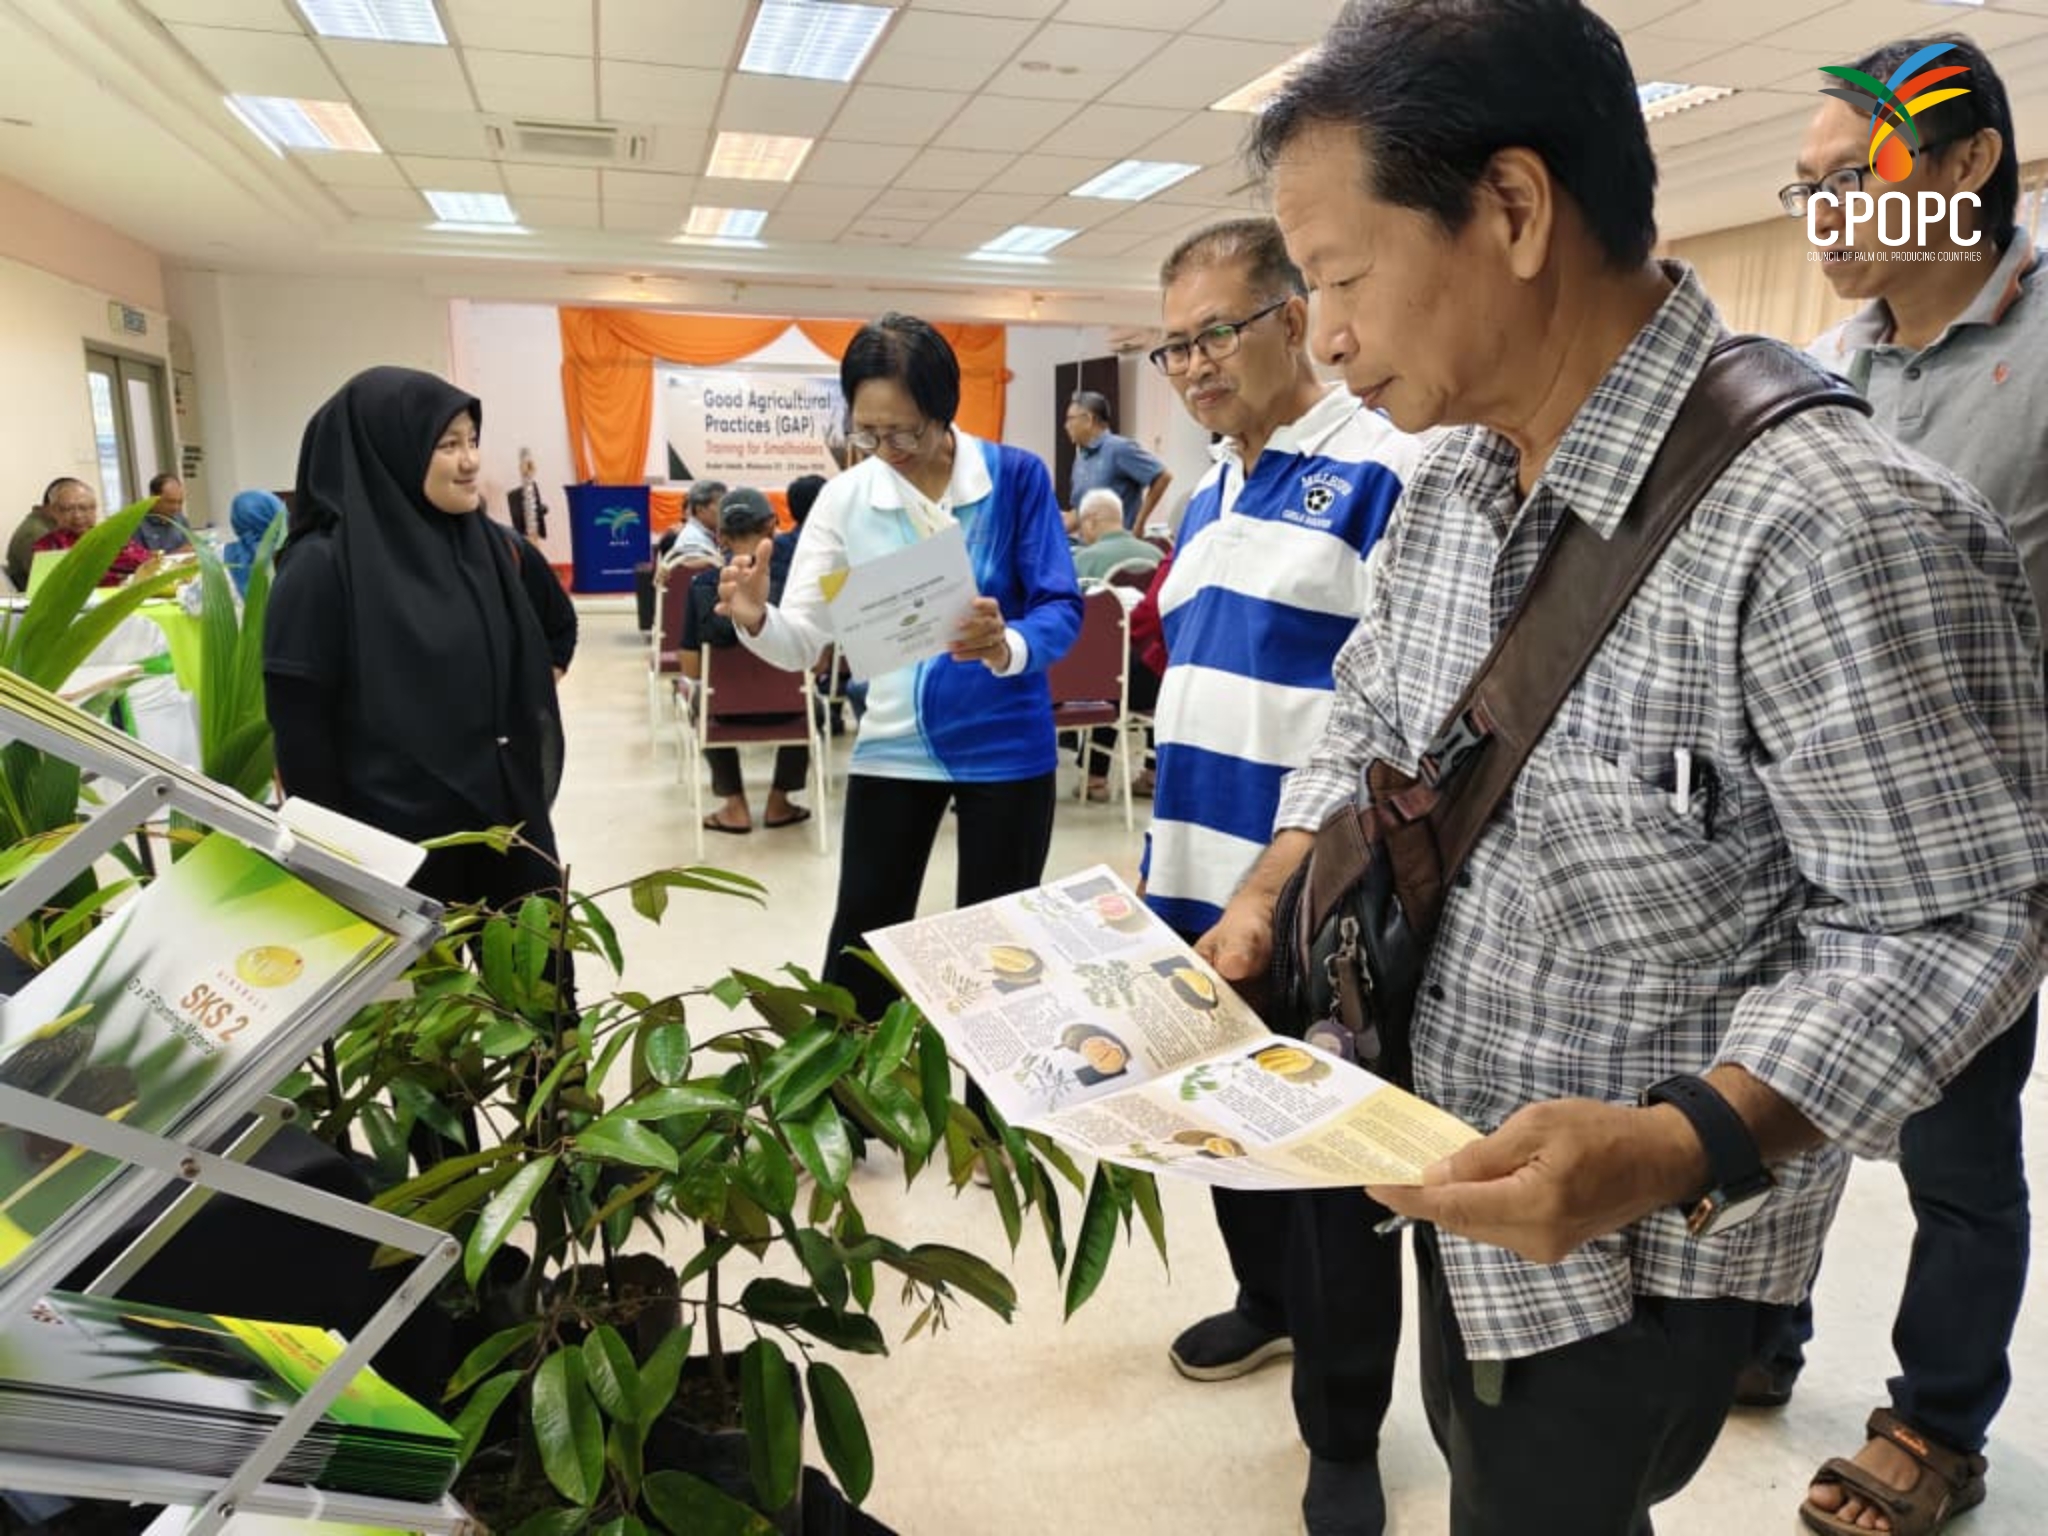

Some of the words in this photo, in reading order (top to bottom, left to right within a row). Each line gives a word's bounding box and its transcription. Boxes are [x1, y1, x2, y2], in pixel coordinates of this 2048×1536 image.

[703, 389, 743, 408] Good
[748, 389, 831, 414] Agricultural
[705, 414, 771, 433] Practices
[775, 415, 815, 438] (GAP)
[180, 983, 234, 1029] SKS
[217, 1015, 250, 1042] 2
